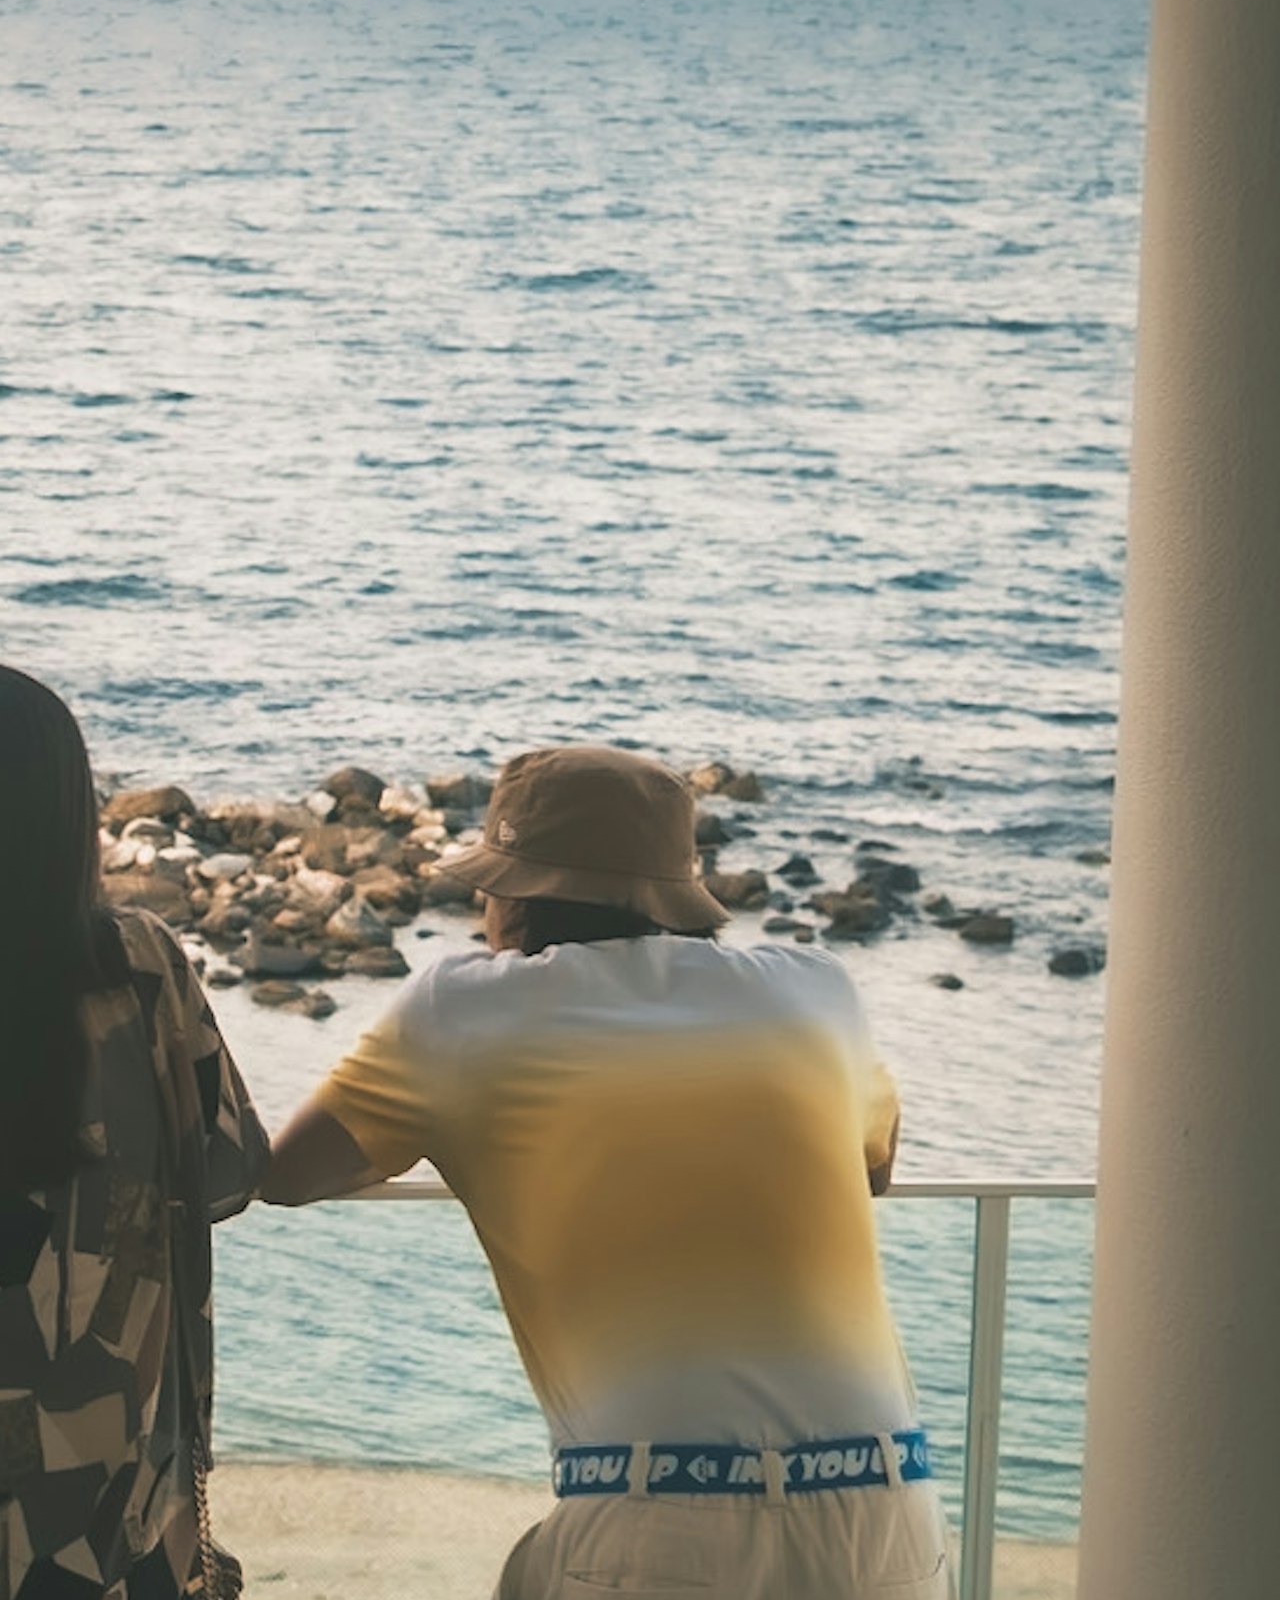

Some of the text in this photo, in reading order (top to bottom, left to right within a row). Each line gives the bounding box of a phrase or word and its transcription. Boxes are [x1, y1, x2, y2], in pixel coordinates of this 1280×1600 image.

[570, 1455, 626, 1484] YOU
[625, 1454, 679, 1482] P
[800, 1448, 868, 1482] YOU
